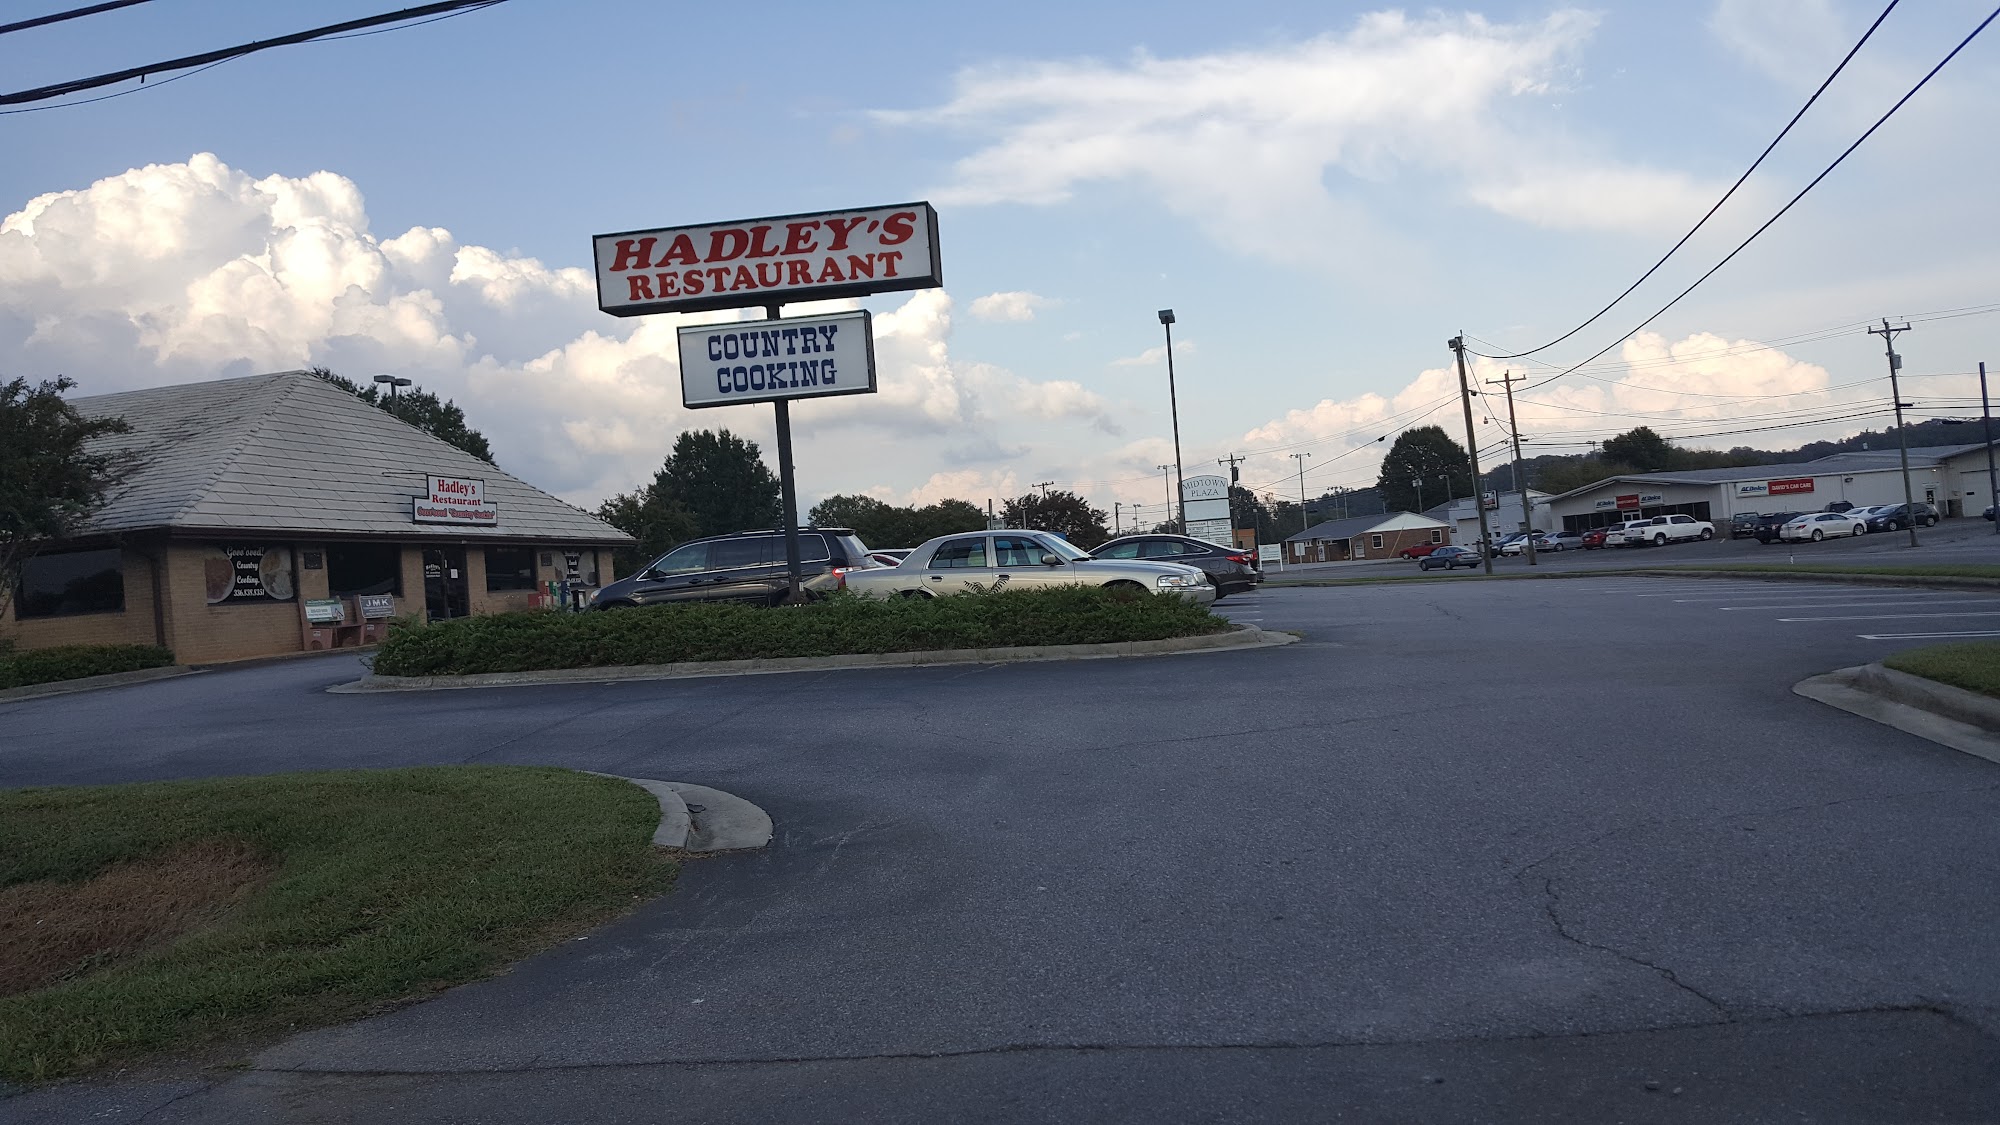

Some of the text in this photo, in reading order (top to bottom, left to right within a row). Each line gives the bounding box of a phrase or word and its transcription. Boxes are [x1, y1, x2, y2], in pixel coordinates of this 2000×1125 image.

[609, 212, 916, 272] HADLEY'S
[627, 251, 903, 301] RESTAURANT
[708, 325, 837, 361] COUNTRY
[717, 360, 837, 393] COOKING
[438, 479, 475, 496] Hadley's
[1182, 479, 1226, 491] MIDTOWN
[1191, 488, 1219, 498] PLAZA
[432, 494, 481, 506] Restaurant
[236, 560, 259, 571] Country
